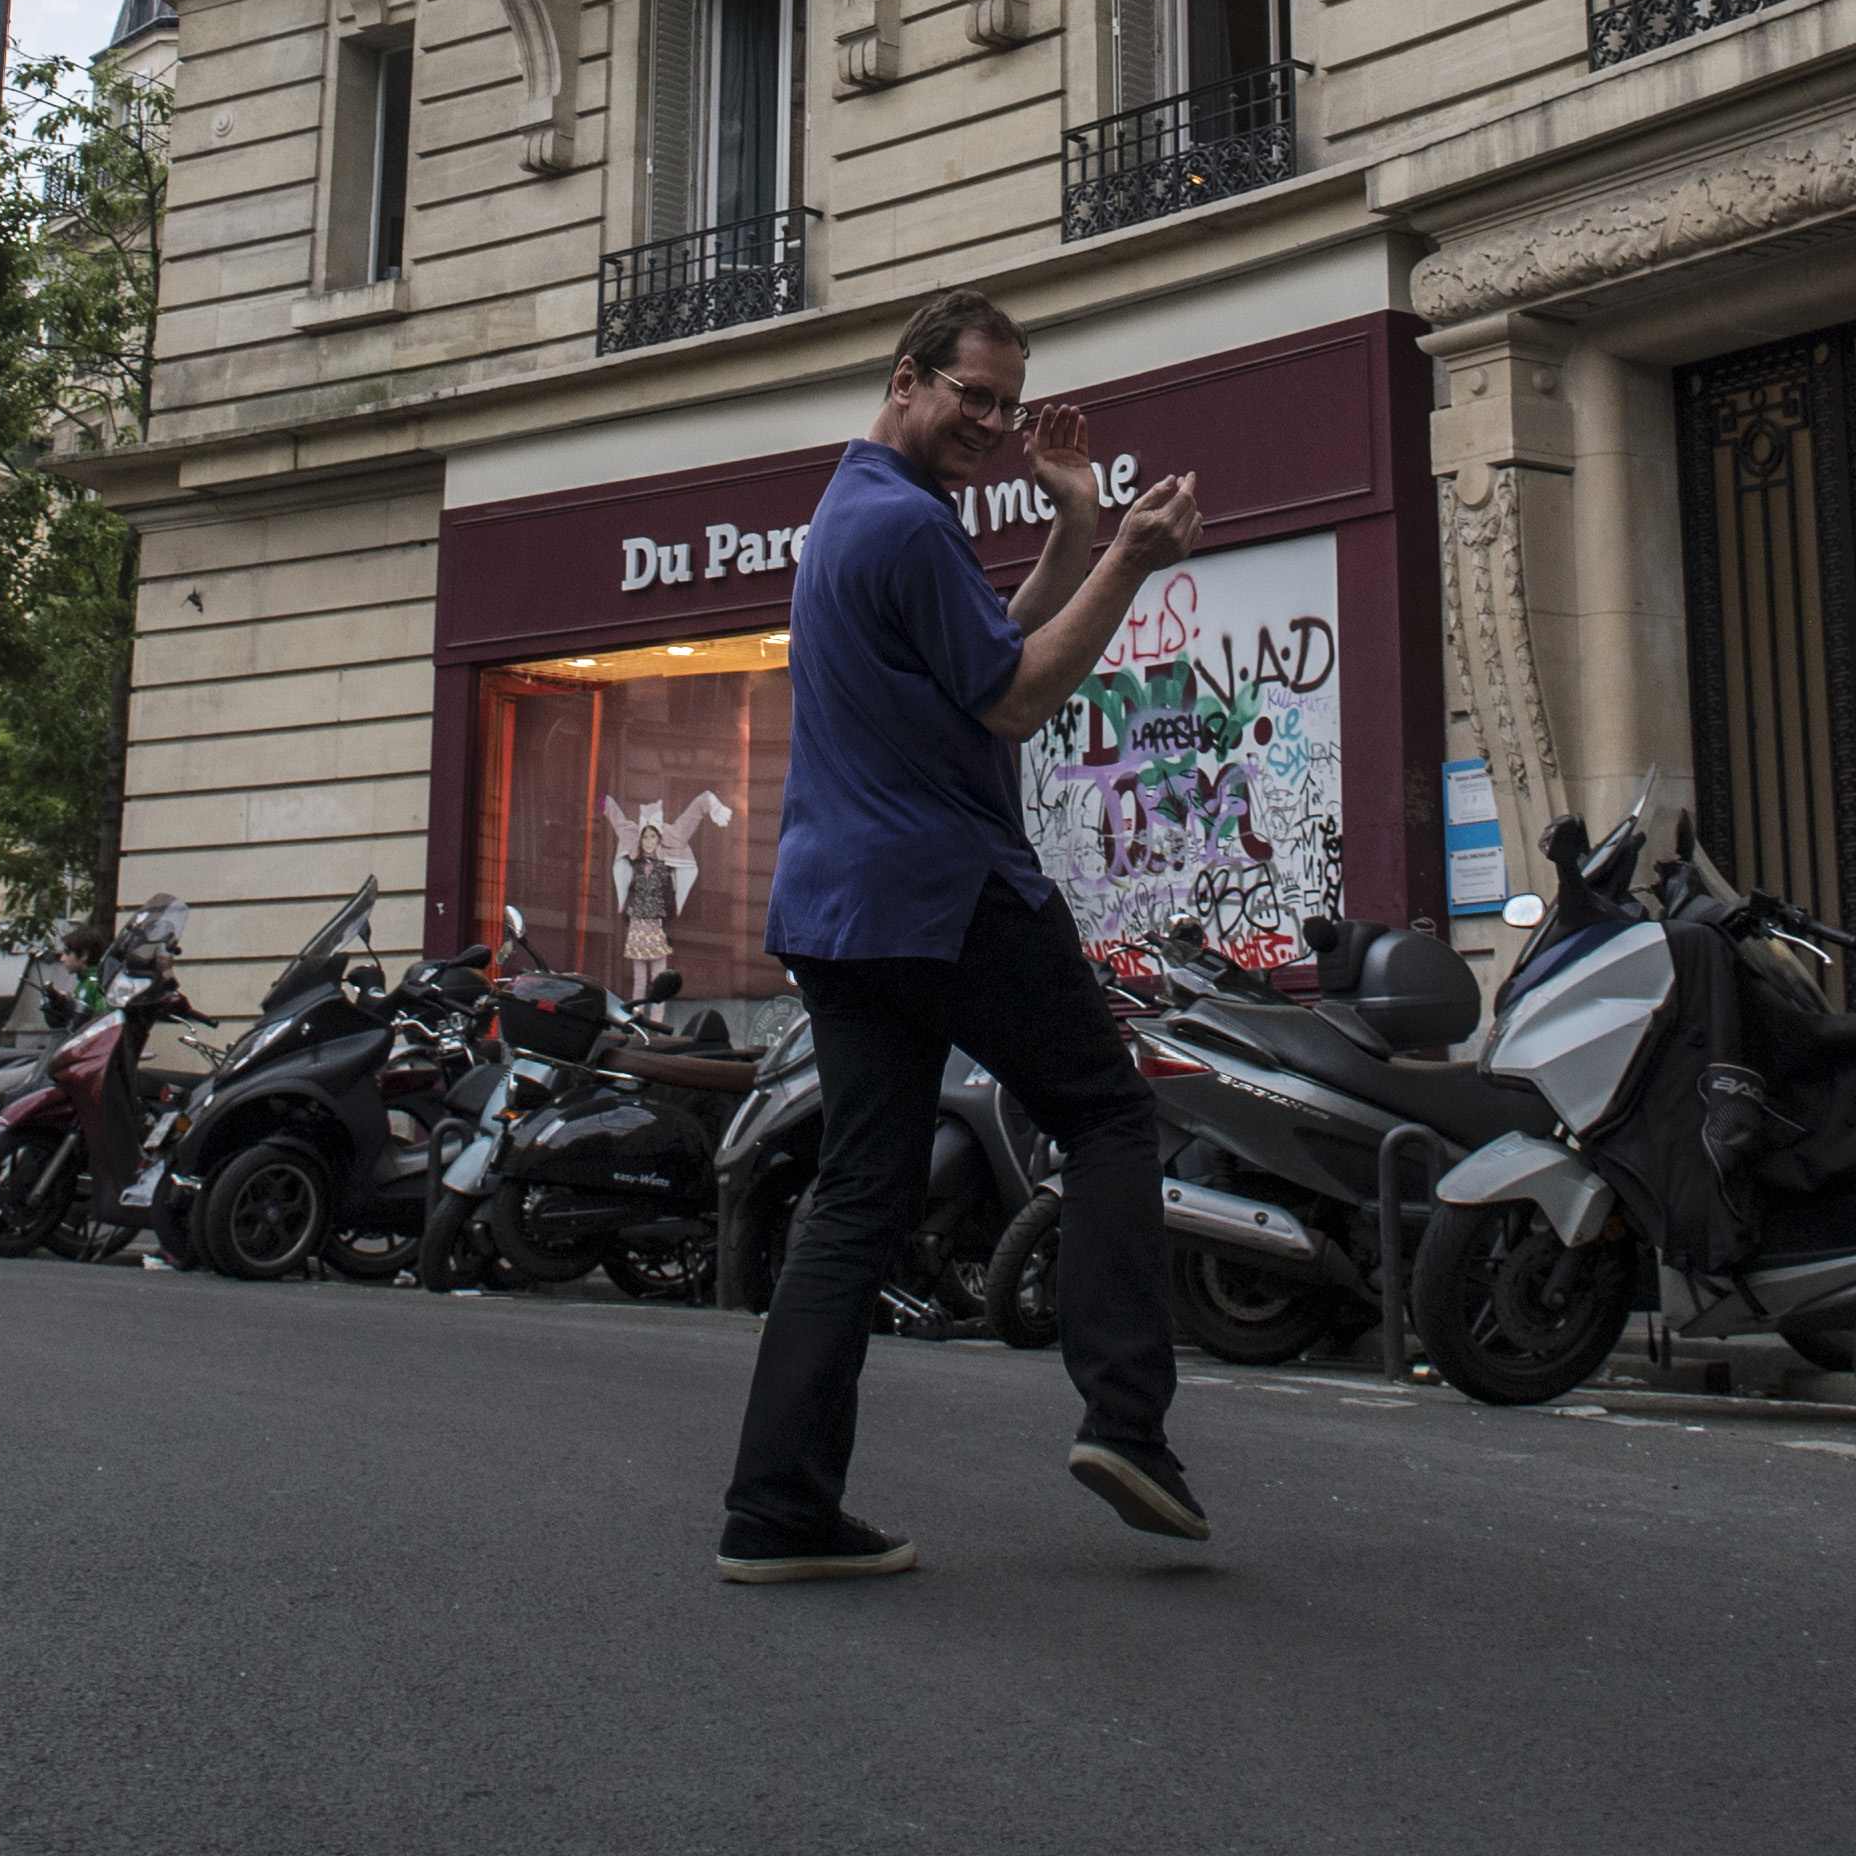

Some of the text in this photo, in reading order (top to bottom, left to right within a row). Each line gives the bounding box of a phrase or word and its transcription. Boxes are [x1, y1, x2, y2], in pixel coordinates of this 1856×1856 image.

[621, 453, 1139, 591] Du Pare u me
